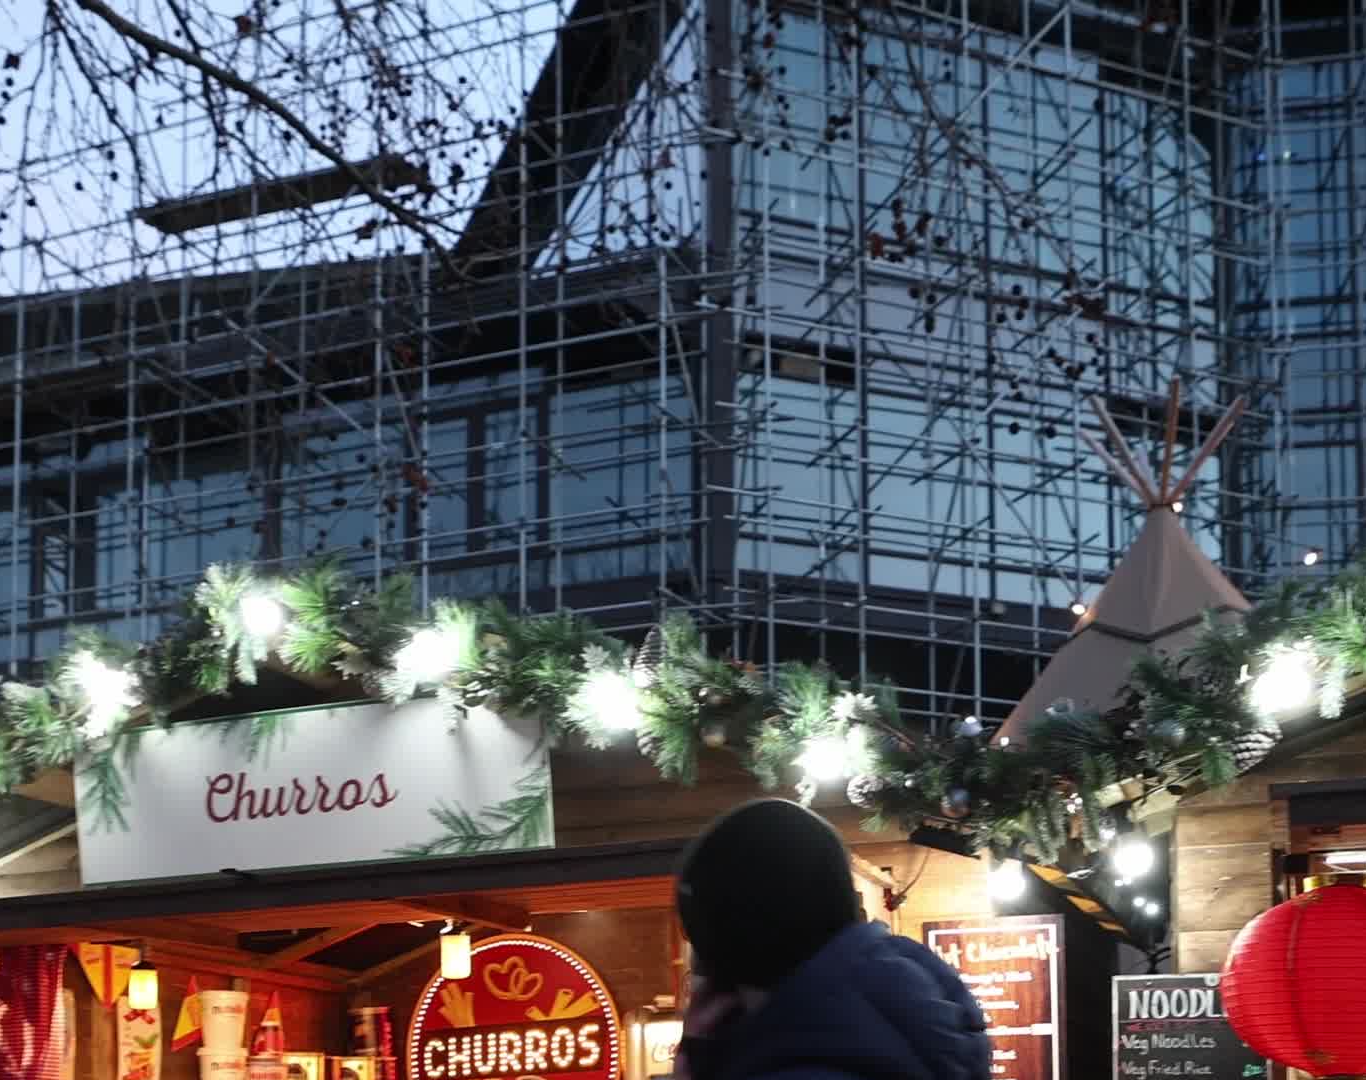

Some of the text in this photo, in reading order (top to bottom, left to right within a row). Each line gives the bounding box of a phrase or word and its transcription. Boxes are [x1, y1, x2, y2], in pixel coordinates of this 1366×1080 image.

[205, 773, 399, 823] Churros
[1129, 989, 1229, 1019] NOODL
[423, 1024, 600, 1077] CHURROS
[1121, 1033, 1216, 1055] Veg Noodles
[1120, 1060, 1213, 1080] Veg Fried Rice
